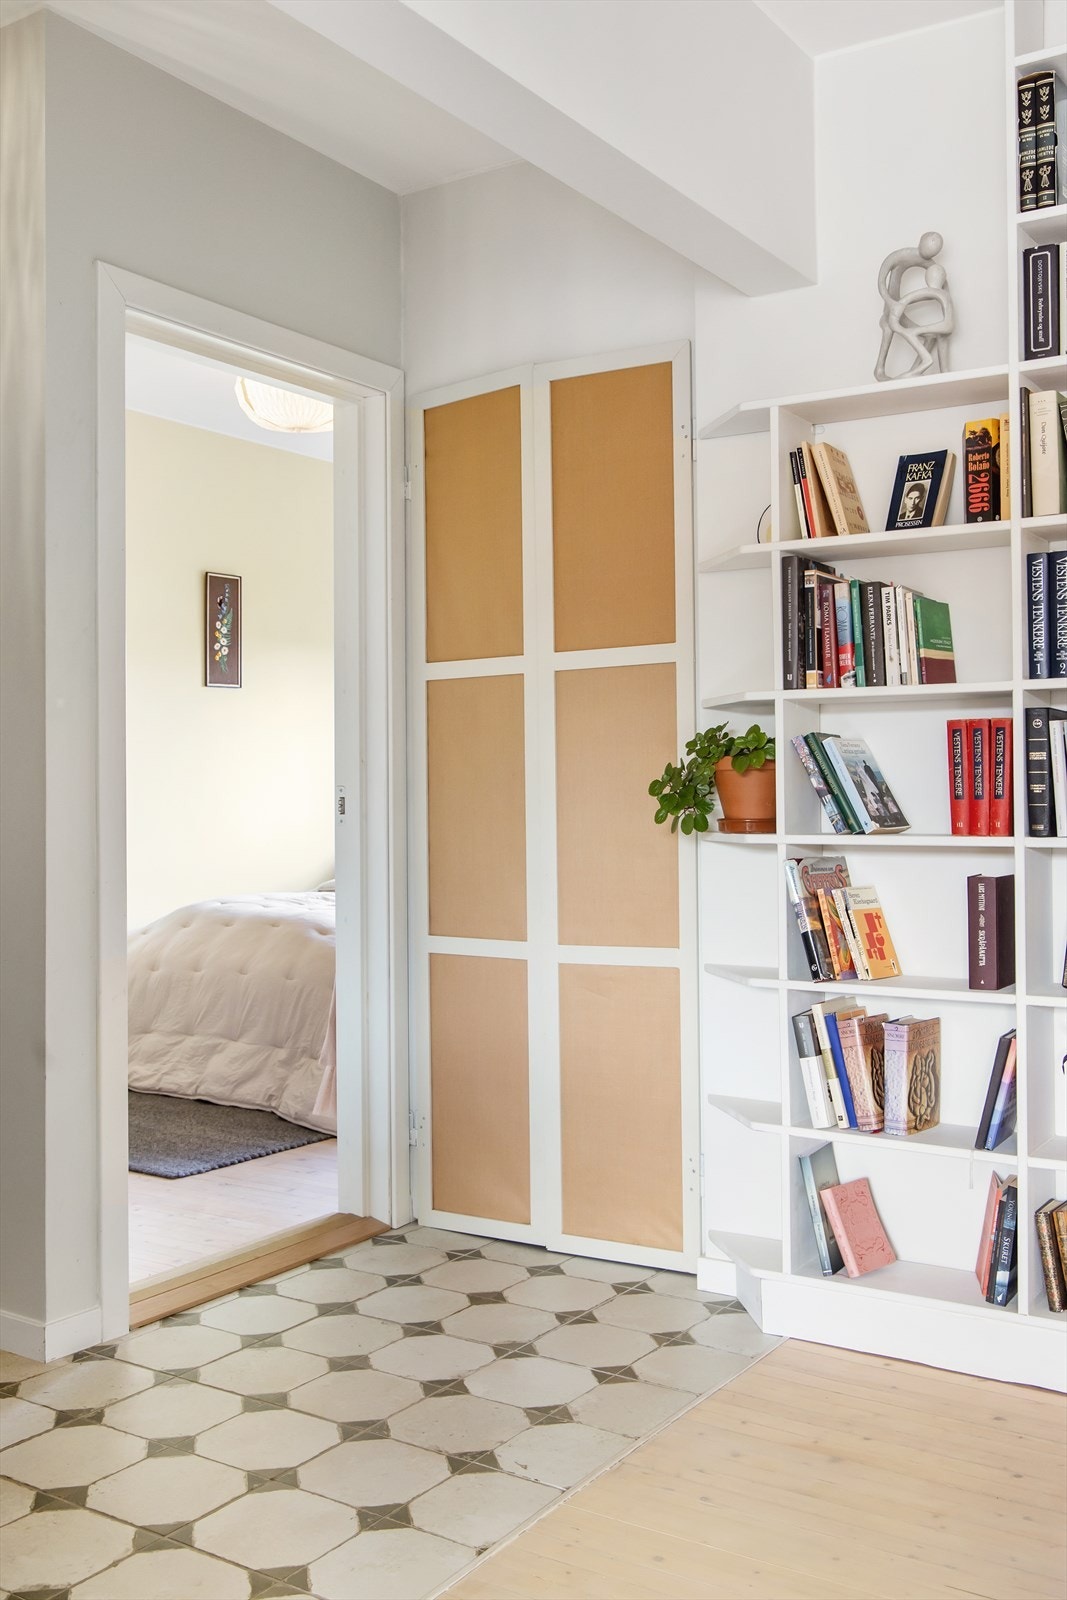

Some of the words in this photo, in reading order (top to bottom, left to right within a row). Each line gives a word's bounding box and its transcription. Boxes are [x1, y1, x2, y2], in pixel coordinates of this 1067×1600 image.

[907, 460, 936, 473] FRANZ
[968, 451, 990, 462] Roberto
[968, 460, 990, 472] Bolaño
[905, 470, 933, 482] KAFKA
[968, 472, 990, 513] 2666
[1031, 557, 1044, 602] VESTENS
[1056, 557, 1067, 601] VESTENS
[836, 605, 848, 634] ROMA
[1032, 602, 1045, 650] TENKERE
[1056, 603, 1067, 650] TENKERE
[1035, 663, 1042, 675] 1
[1059, 662, 1066, 674] 2
[953, 731, 962, 762] VESTENS
[974, 731, 982, 762] VESTENS
[996, 730, 1004, 761] VESTENS
[954, 764, 963, 796] TENKERE
[974, 764, 983, 796] TENKERE
[995, 763, 1003, 796] TENKERE
[1005, 1199, 1016, 1225] YOUNG
[1000, 1236, 1011, 1265] SKURET
